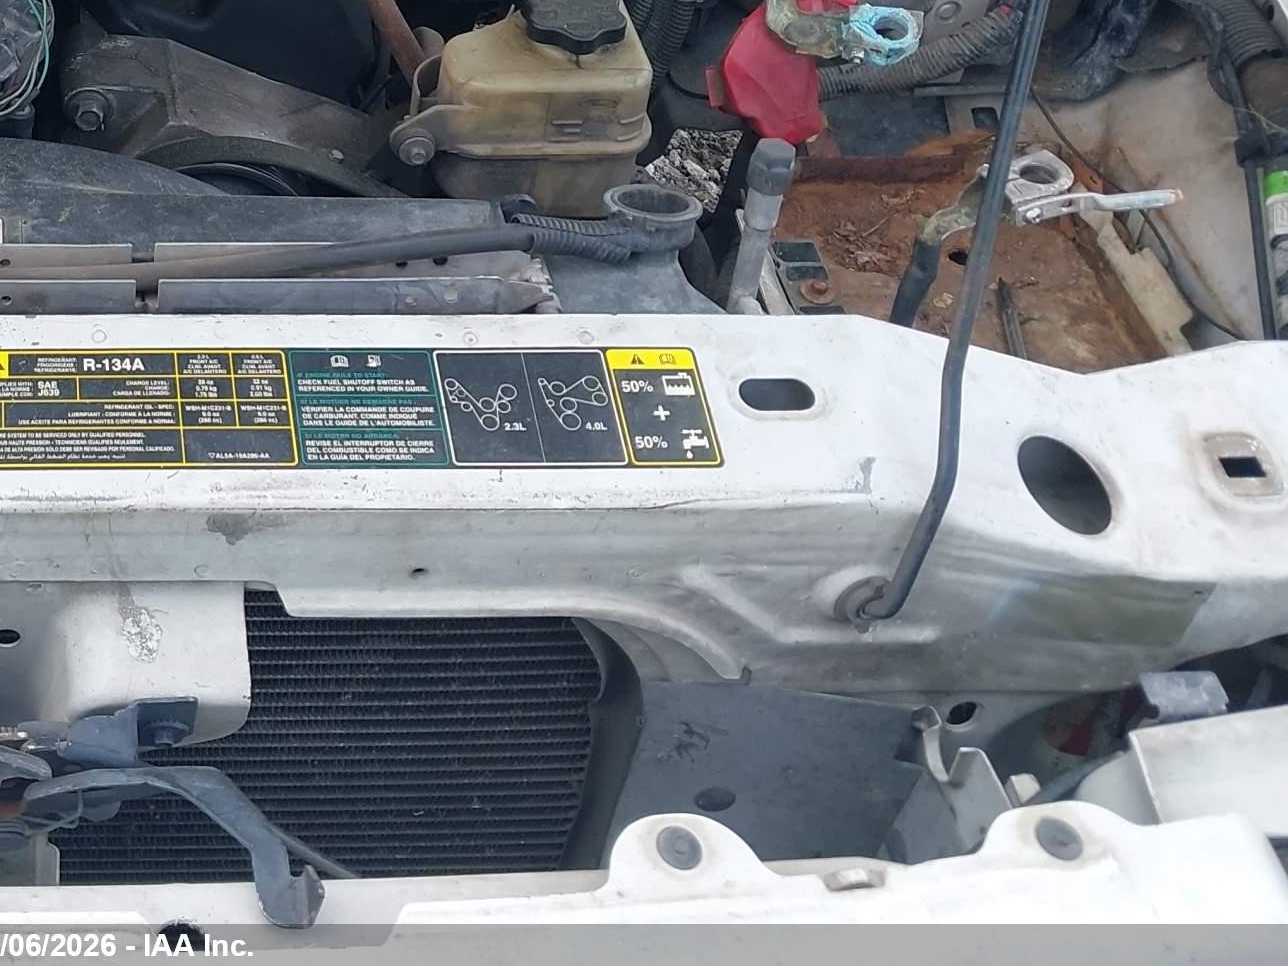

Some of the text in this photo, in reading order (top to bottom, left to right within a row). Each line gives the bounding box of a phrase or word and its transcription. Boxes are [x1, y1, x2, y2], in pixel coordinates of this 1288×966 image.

[83, 358, 144, 371] R-134A
[37, 381, 57, 389] SAE
[621, 381, 654, 393] 50%
[504, 423, 527, 431] 2.3L
[586, 422, 607, 430] 4.0L
[635, 436, 668, 448] 50%
